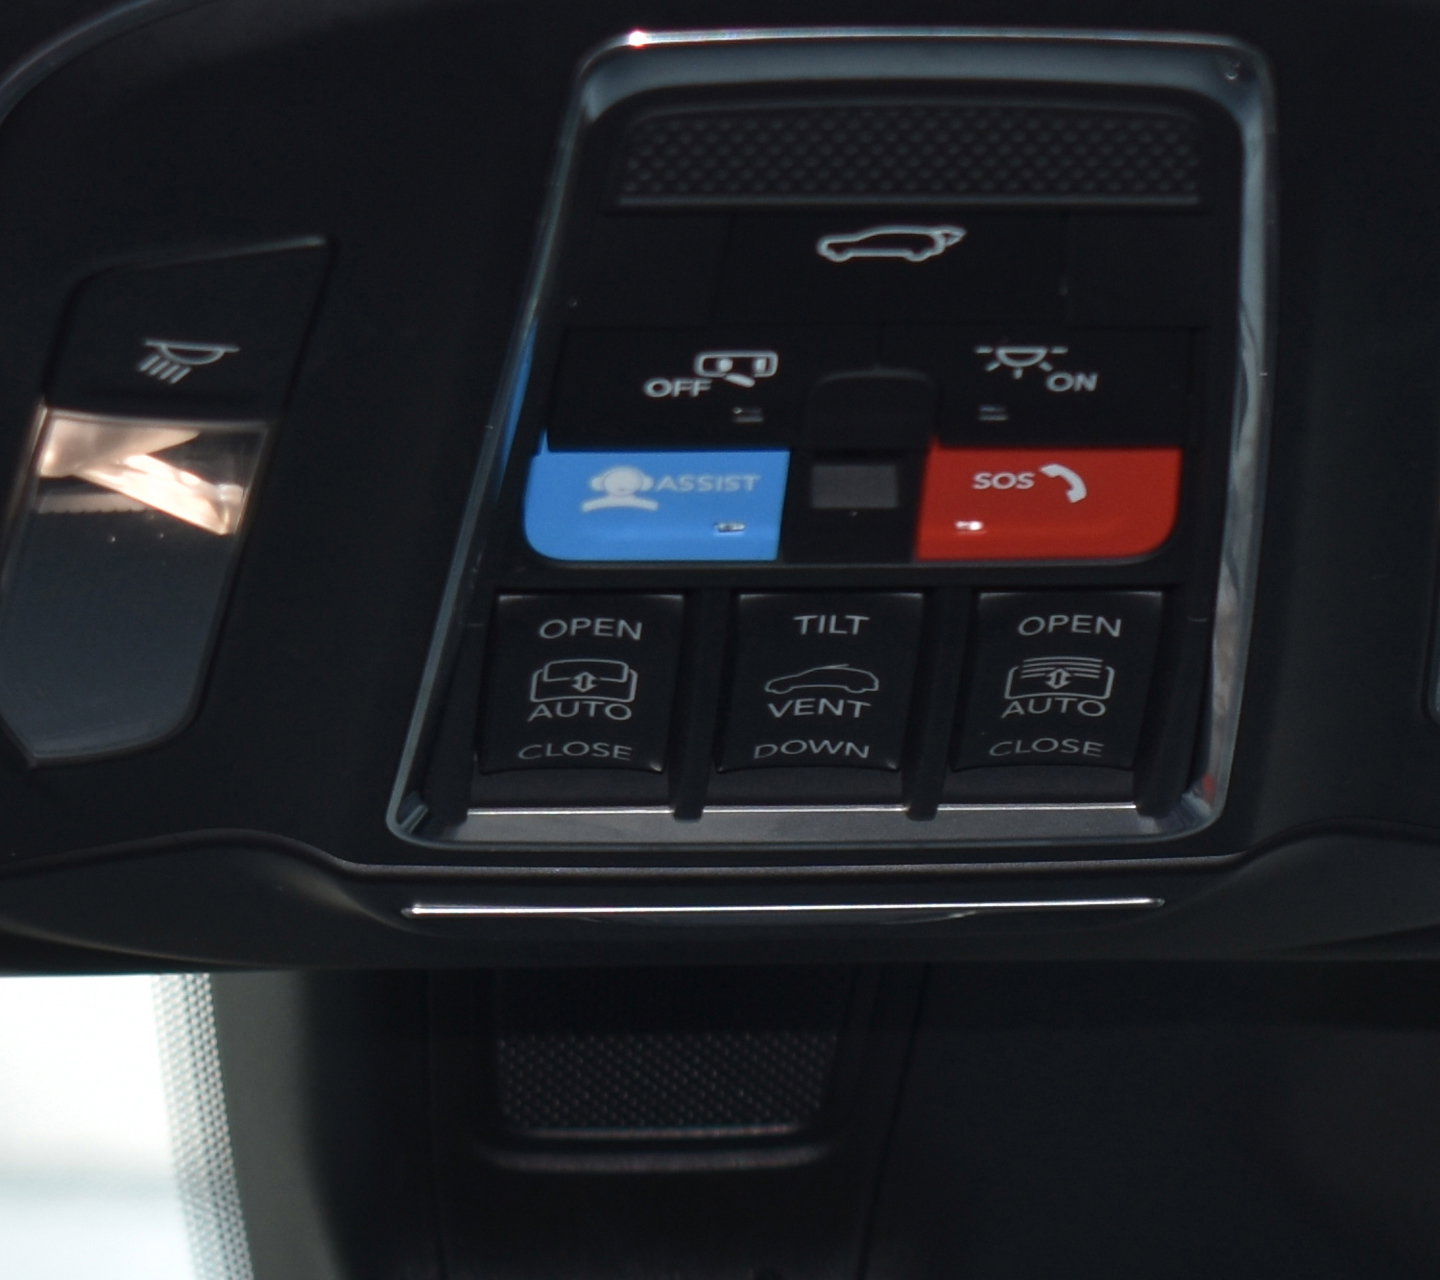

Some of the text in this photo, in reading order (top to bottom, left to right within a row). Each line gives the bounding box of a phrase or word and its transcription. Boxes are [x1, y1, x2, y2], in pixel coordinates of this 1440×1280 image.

[642, 376, 713, 399] OFF
[1045, 371, 1100, 393] ON
[655, 474, 760, 493] ASSIST
[972, 471, 1036, 490] SOS
[538, 616, 643, 641] OPEN
[793, 614, 871, 635] TILT
[1017, 614, 1122, 637] OPEN
[527, 700, 633, 722] AUTO
[767, 697, 871, 719] VENT
[1000, 697, 1106, 719] AUTO
[517, 741, 633, 761] CLOSE
[753, 739, 870, 760] DOWN
[989, 737, 1105, 757] CLOSE
